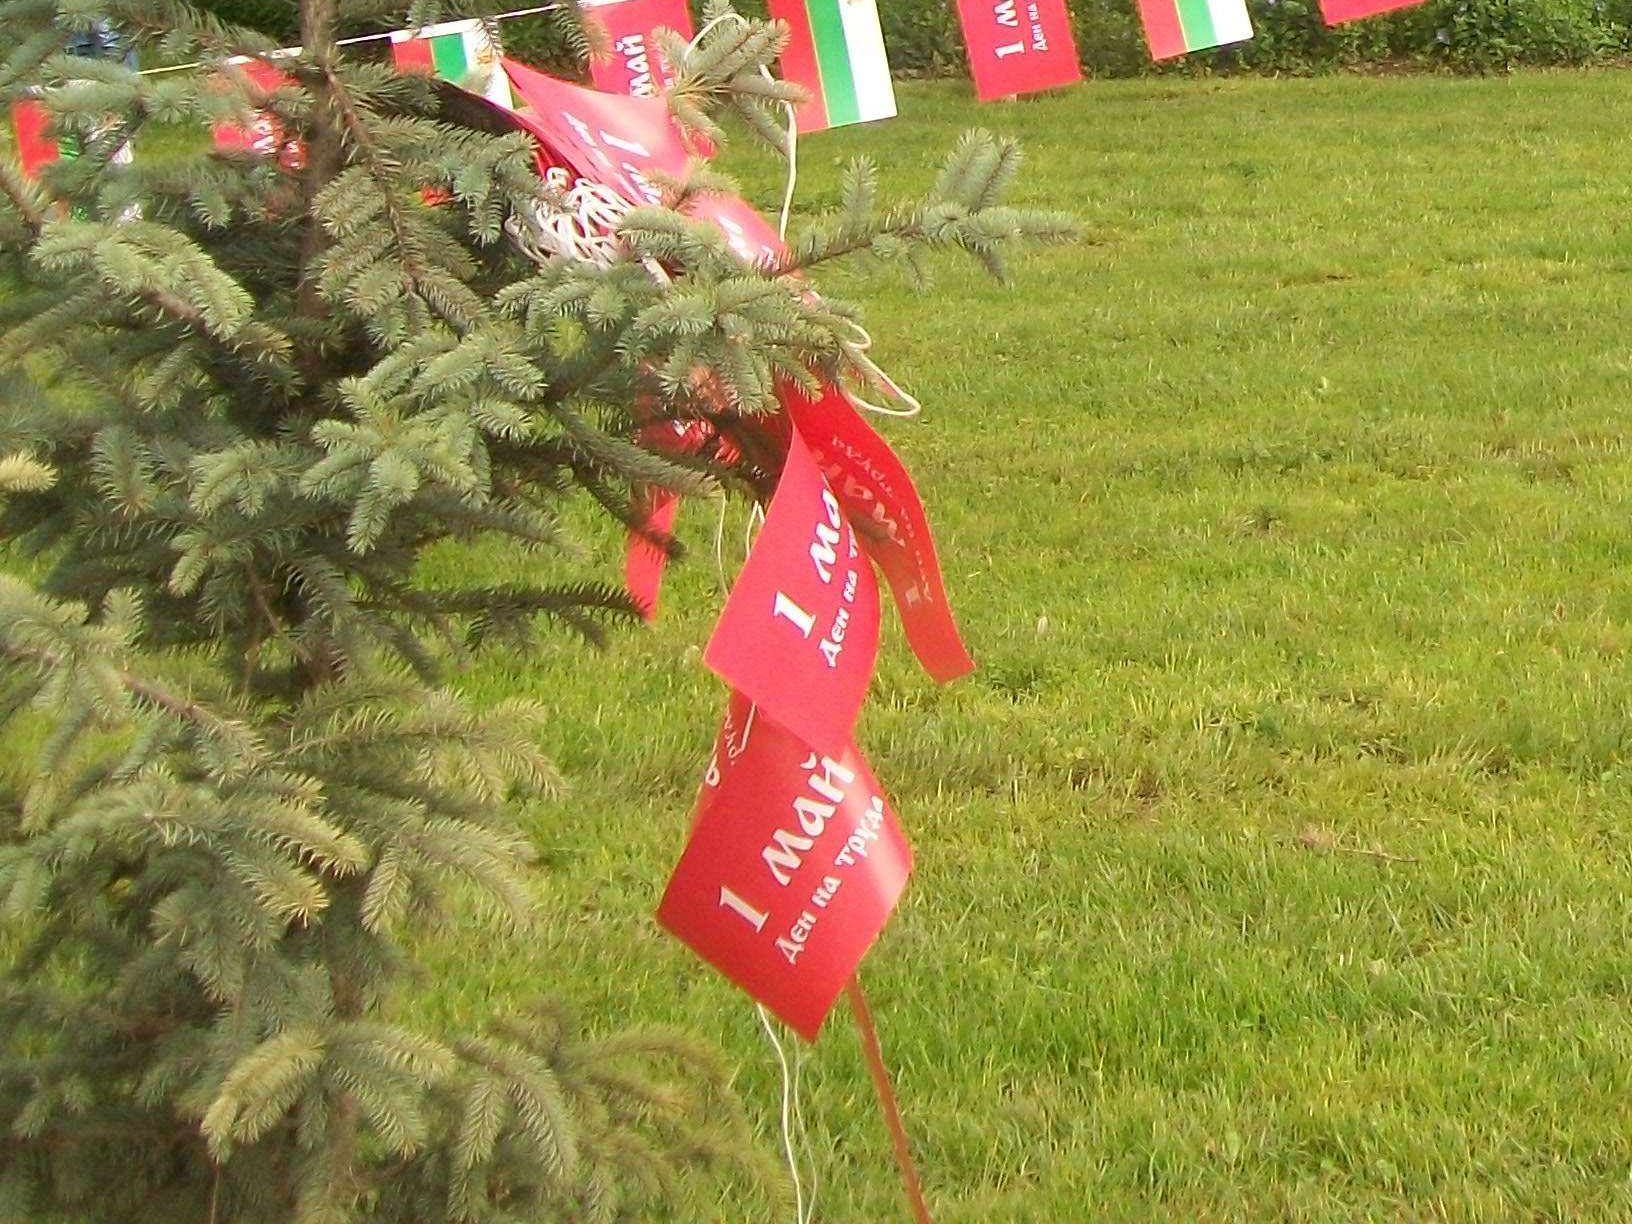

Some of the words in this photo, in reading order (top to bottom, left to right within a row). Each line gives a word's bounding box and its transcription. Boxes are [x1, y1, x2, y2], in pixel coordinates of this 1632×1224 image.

[994, 39, 1025, 59] 1
[1027, 3, 1040, 21] на
[1031, 23, 1049, 51] Ден
[773, 590, 817, 640] 1
[809, 488, 842, 584] ма
[818, 606, 851, 668] Ден
[842, 568, 859, 604] на
[719, 885, 770, 934] 1
[761, 751, 856, 887] май
[774, 910, 818, 965] Ден
[810, 874, 843, 909] на
[833, 794, 885, 867] труда
